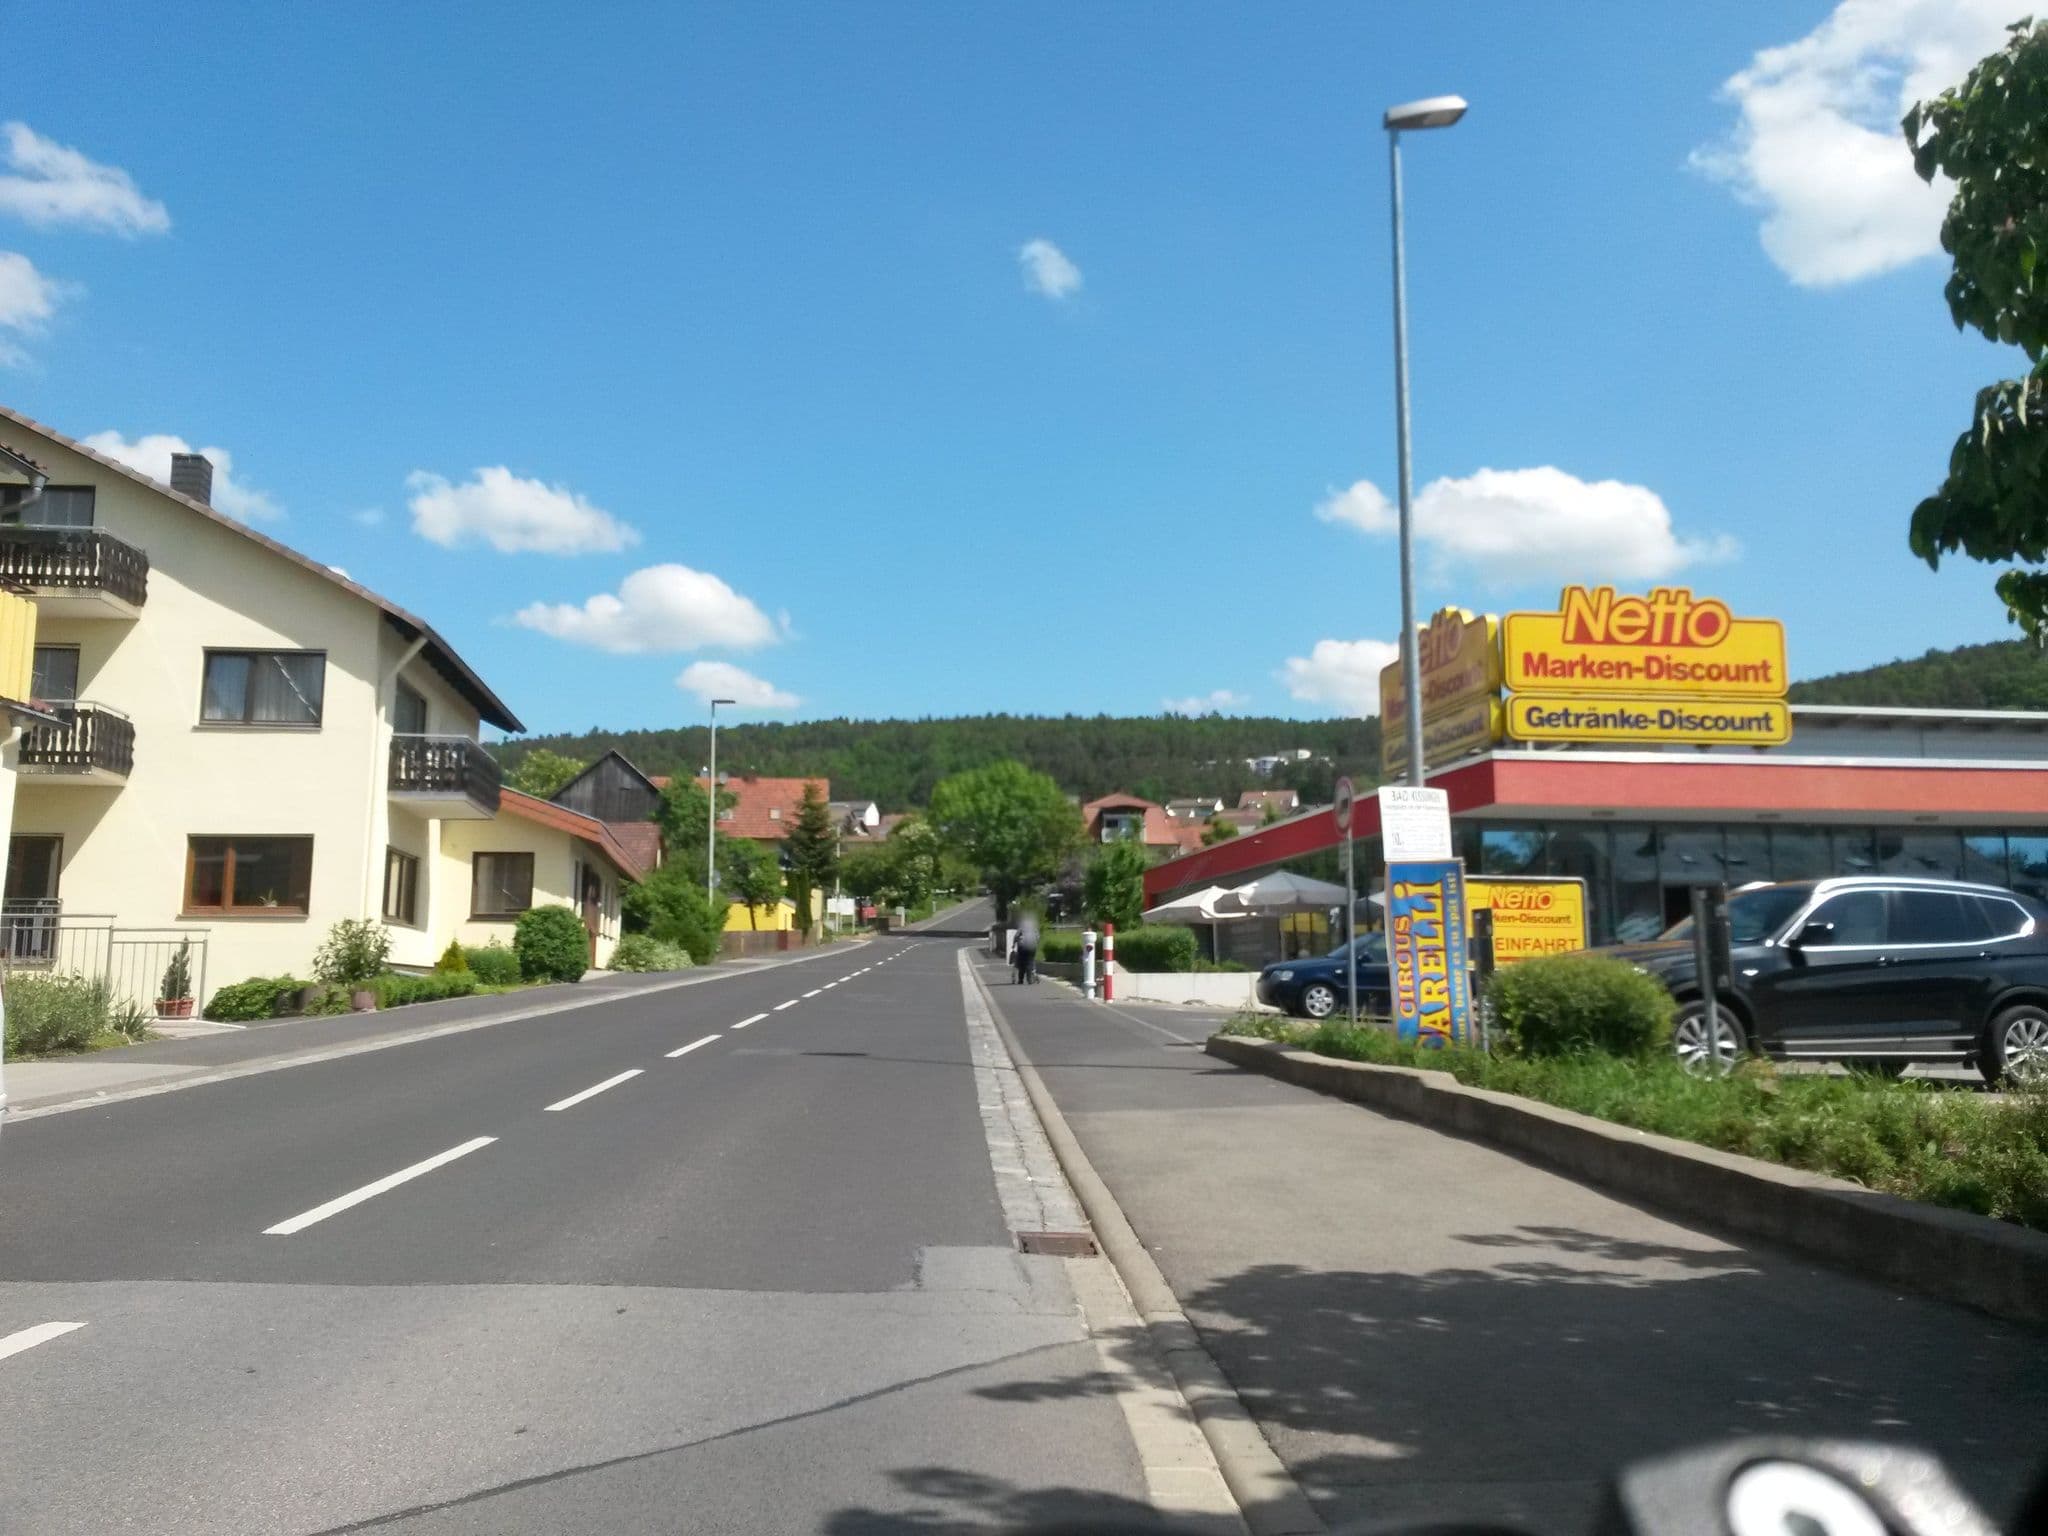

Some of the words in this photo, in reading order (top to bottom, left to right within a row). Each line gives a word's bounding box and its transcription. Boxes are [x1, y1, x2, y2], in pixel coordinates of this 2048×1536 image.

[1564, 587, 1729, 646] Netto
[1522, 651, 1772, 683] Marken-Discount
[1525, 704, 1774, 733] Getränke-Discount
[1489, 885, 1554, 910] Netto
[1493, 912, 1572, 925] ken-Discount
[1495, 937, 1579, 952] EINFAHRT
[1393, 915, 1418, 1019] CIRCUS
